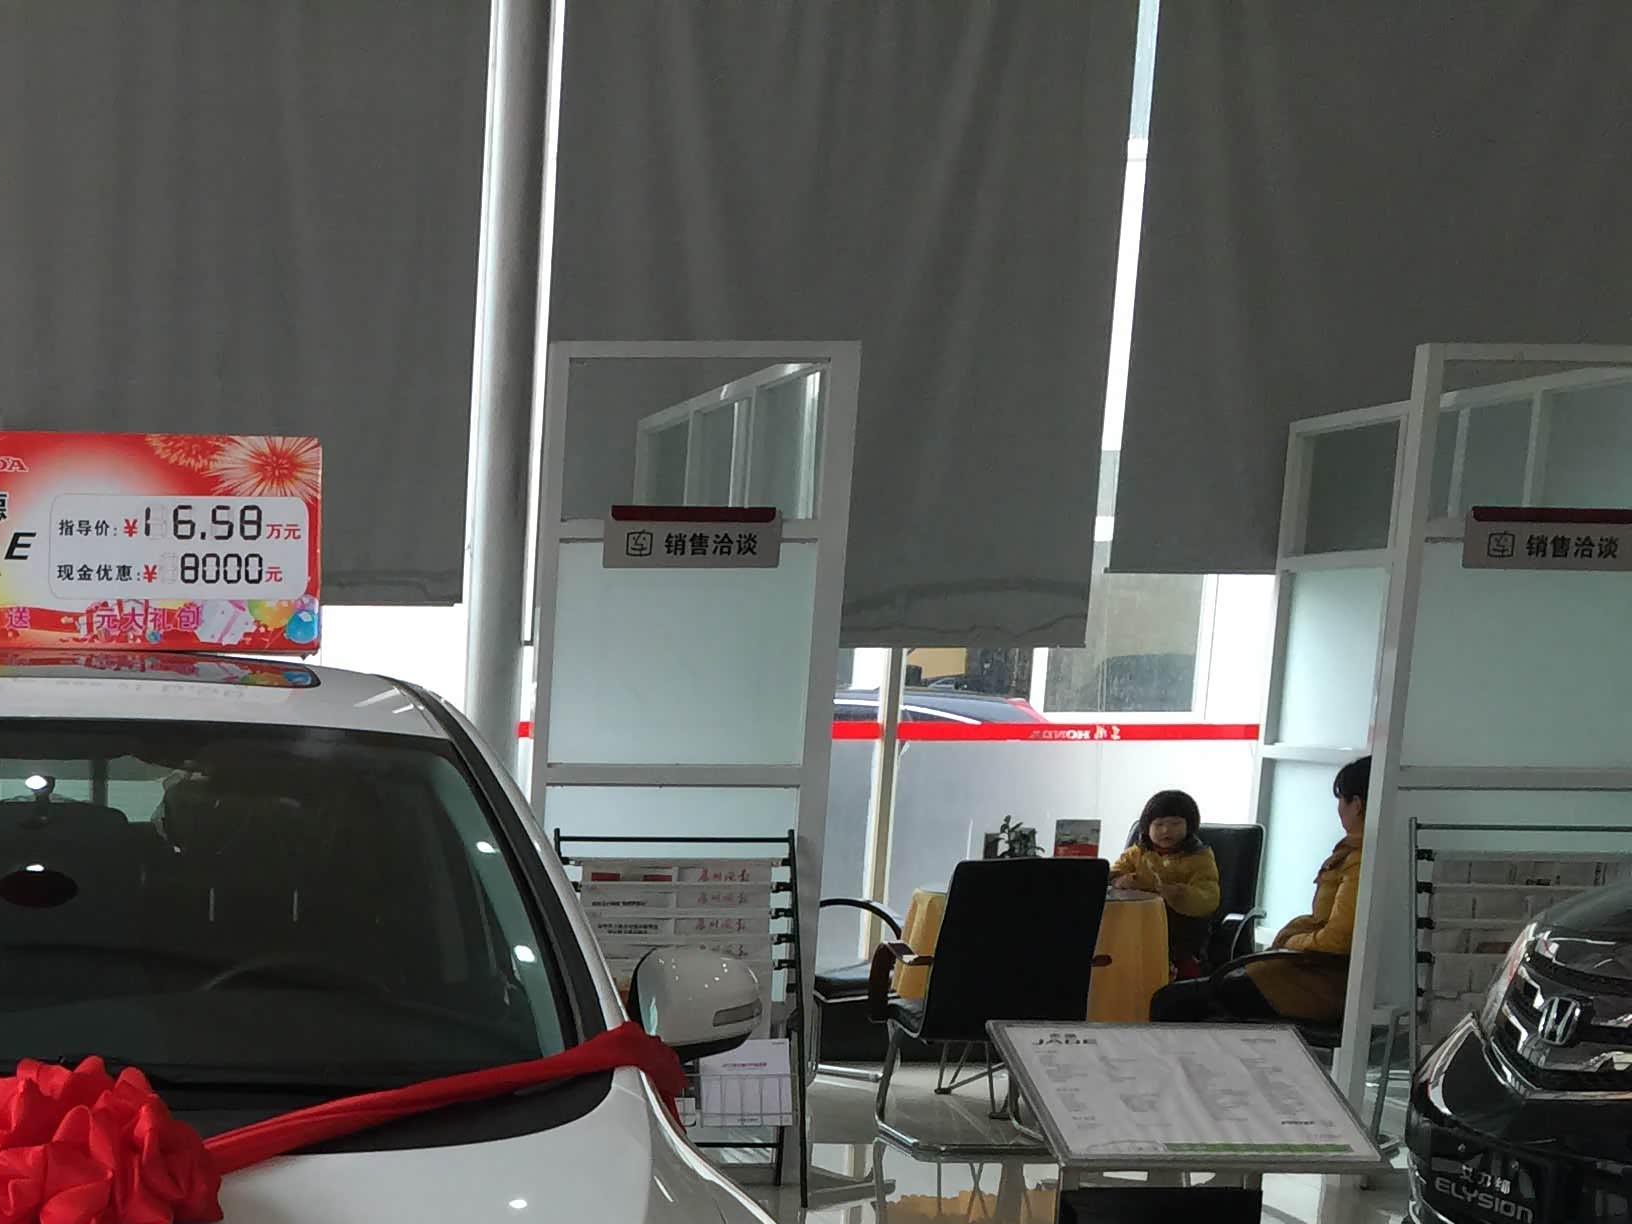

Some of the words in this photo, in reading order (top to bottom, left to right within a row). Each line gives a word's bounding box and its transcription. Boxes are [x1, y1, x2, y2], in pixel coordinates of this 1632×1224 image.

[663, 532, 758, 556] 销售洽谈
[1525, 534, 1619, 559] 销售洽谈
[1434, 1176, 1535, 1224] ELYSION
